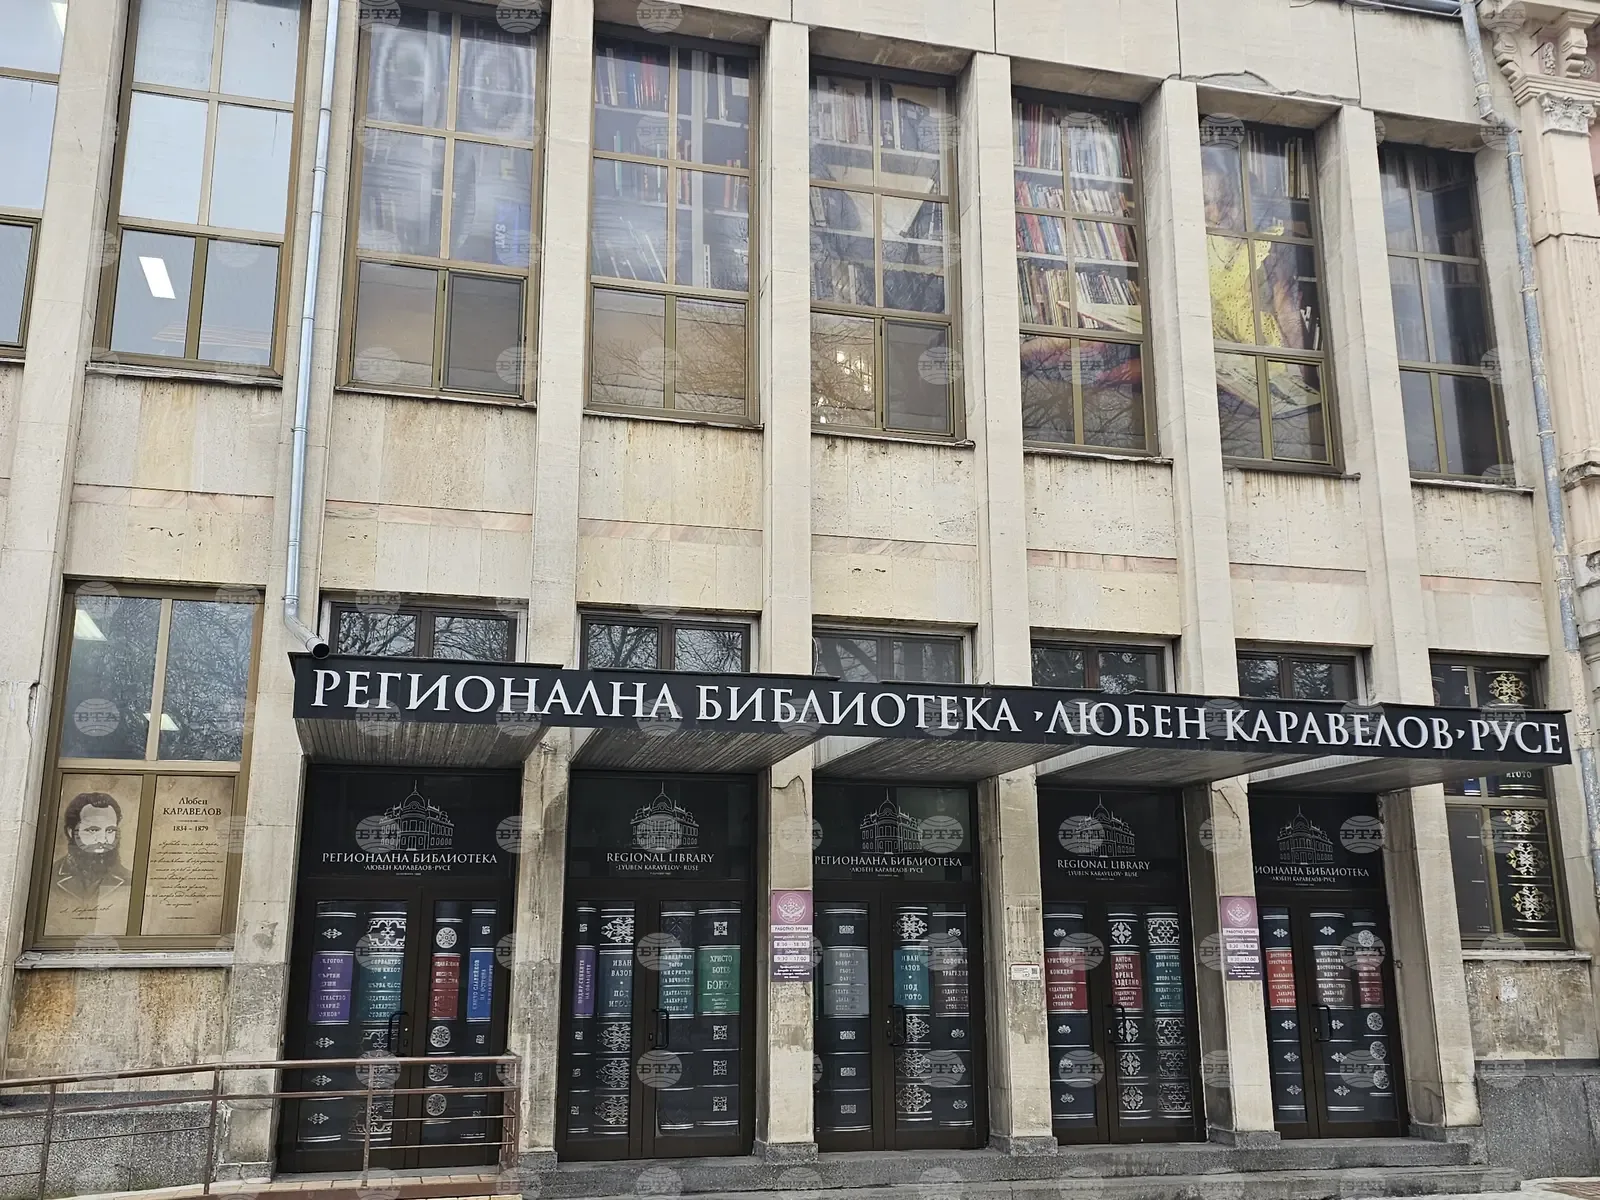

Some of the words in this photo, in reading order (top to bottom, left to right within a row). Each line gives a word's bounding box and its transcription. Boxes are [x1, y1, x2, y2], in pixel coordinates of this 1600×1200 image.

[311, 669, 683, 719] РЕГИОНАЛНА
[696, 685, 1022, 732] БИБЛИОТЕКА
[179, 797, 208, 805] Любен
[163, 808, 222, 816] КАРАВЕЛОВ
[322, 853, 409, 863] РЕГИОНАЛНА
[413, 853, 497, 864] БИБЛИОТЕКА
[607, 853, 666, 862] REGIONAL
[669, 853, 715, 863] LIBRARY
[815, 856, 887, 866] РЕГИОНАЛНА
[891, 857, 962, 867] БИБЛИОТЕКА
[1057, 859, 1108, 869] REGIONAL
[1111, 860, 1150, 870] LIBRARY
[1306, 867, 1370, 877] БИБЛИОТЕКА
[709, 955, 733, 963] ХРИСТО
[1115, 971, 1134, 979] ВРЕМЕ
